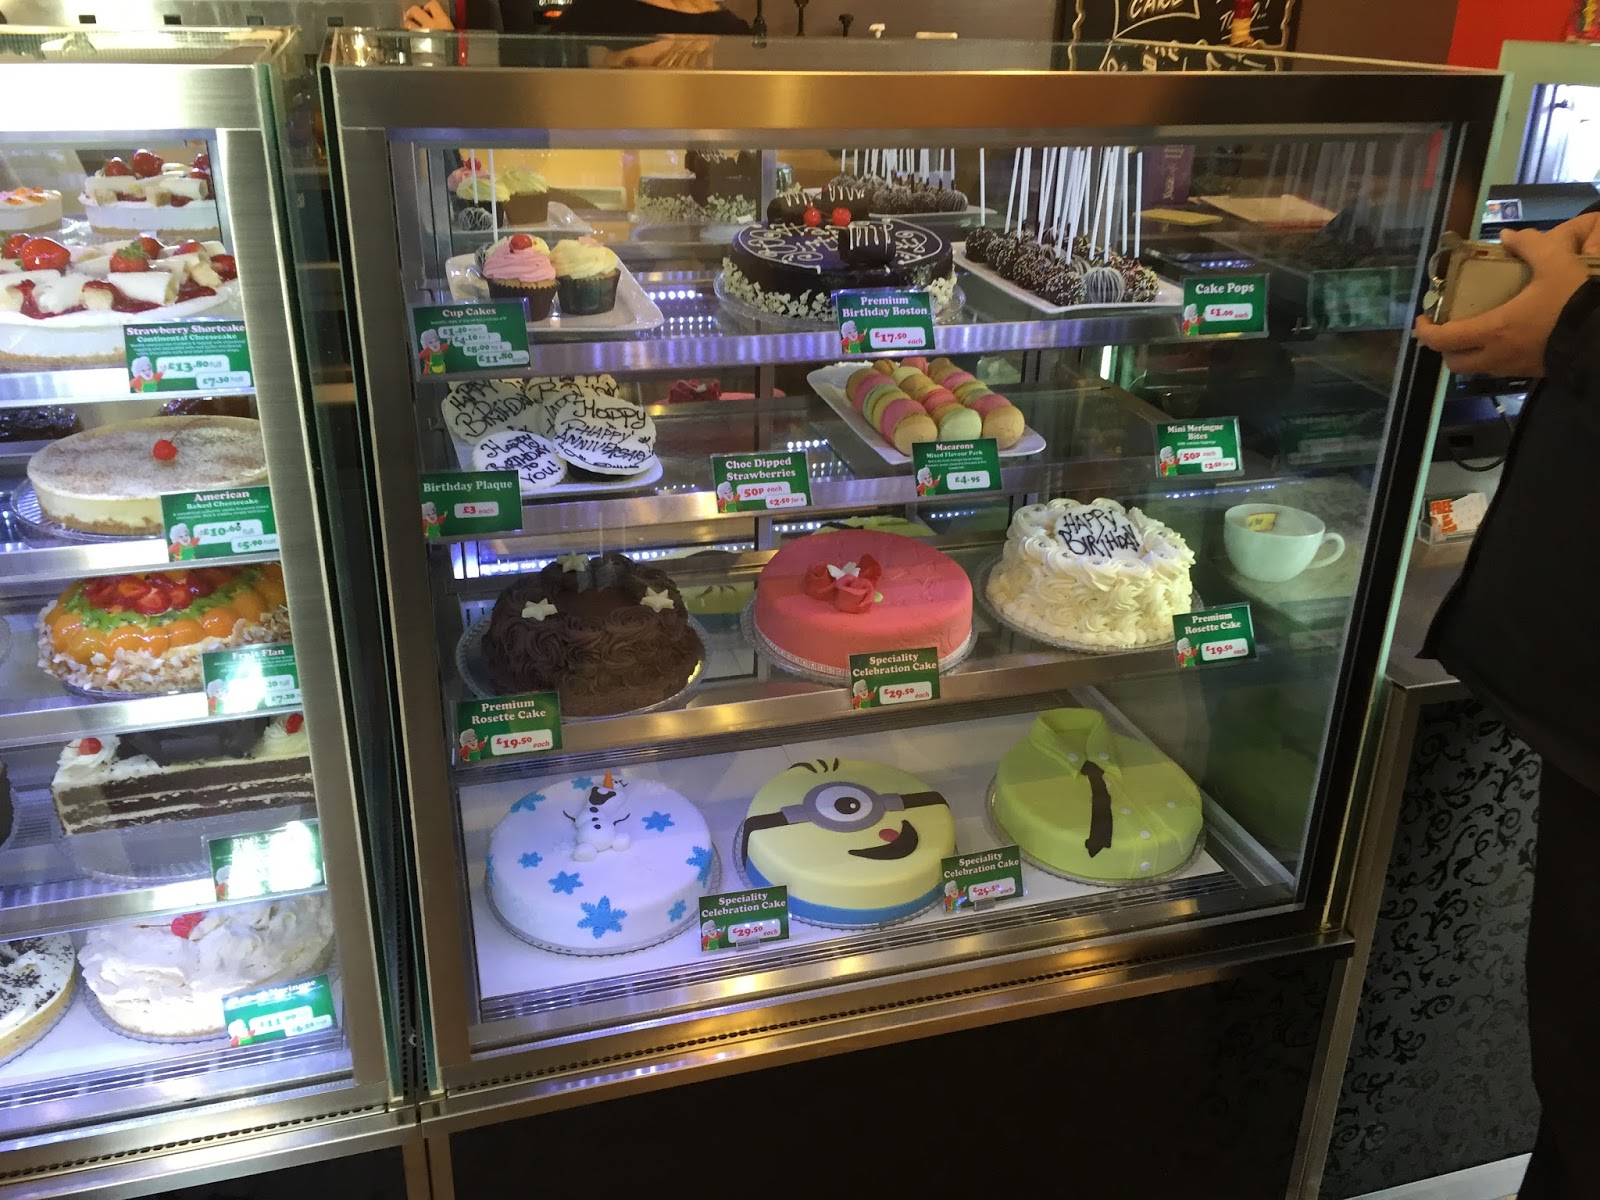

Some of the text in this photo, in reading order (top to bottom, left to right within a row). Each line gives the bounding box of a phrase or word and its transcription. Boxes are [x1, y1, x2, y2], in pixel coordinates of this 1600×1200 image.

[1195, 282, 1255, 295] Cake Pops
[861, 296, 909, 305] Premium
[442, 308, 497, 318] Cup Cakes
[842, 306, 928, 318] Birthday Boston
[126, 324, 245, 336] Strawberry Shortcake
[136, 335, 188, 343] Continental
[874, 332, 907, 343] £17.50
[1167, 424, 1224, 433] Mini Meringue
[936, 443, 974, 451] Macarons
[725, 457, 792, 469] Choc Dipped
[726, 469, 796, 481] Strawberries
[955, 476, 980, 484] £4.95
[423, 481, 513, 492] Birthday Plaque
[194, 490, 250, 502] American
[213, 499, 259, 507] Cheesecake
[463, 506, 476, 514] £3
[1063, 509, 1117, 534] HAPPY
[1058, 524, 1140, 559] BIRTHDAY
[1192, 613, 1233, 623] Premium
[1184, 621, 1241, 634] Rosette Cake
[1205, 645, 1233, 655] £19.50
[869, 653, 918, 666] Speciality
[852, 662, 937, 677] Celebration Cake
[883, 687, 914, 698] £29.50
[481, 700, 535, 712] Premium
[471, 709, 546, 724] Rosette Cake
[496, 737, 532, 748] £19.50
[959, 853, 1003, 867] Speciality
[944, 859, 1019, 878] Celebration Cake
[718, 892, 768, 906] Speciality
[701, 900, 786, 917] Celebration Cake
[733, 926, 763, 937] £29.50
